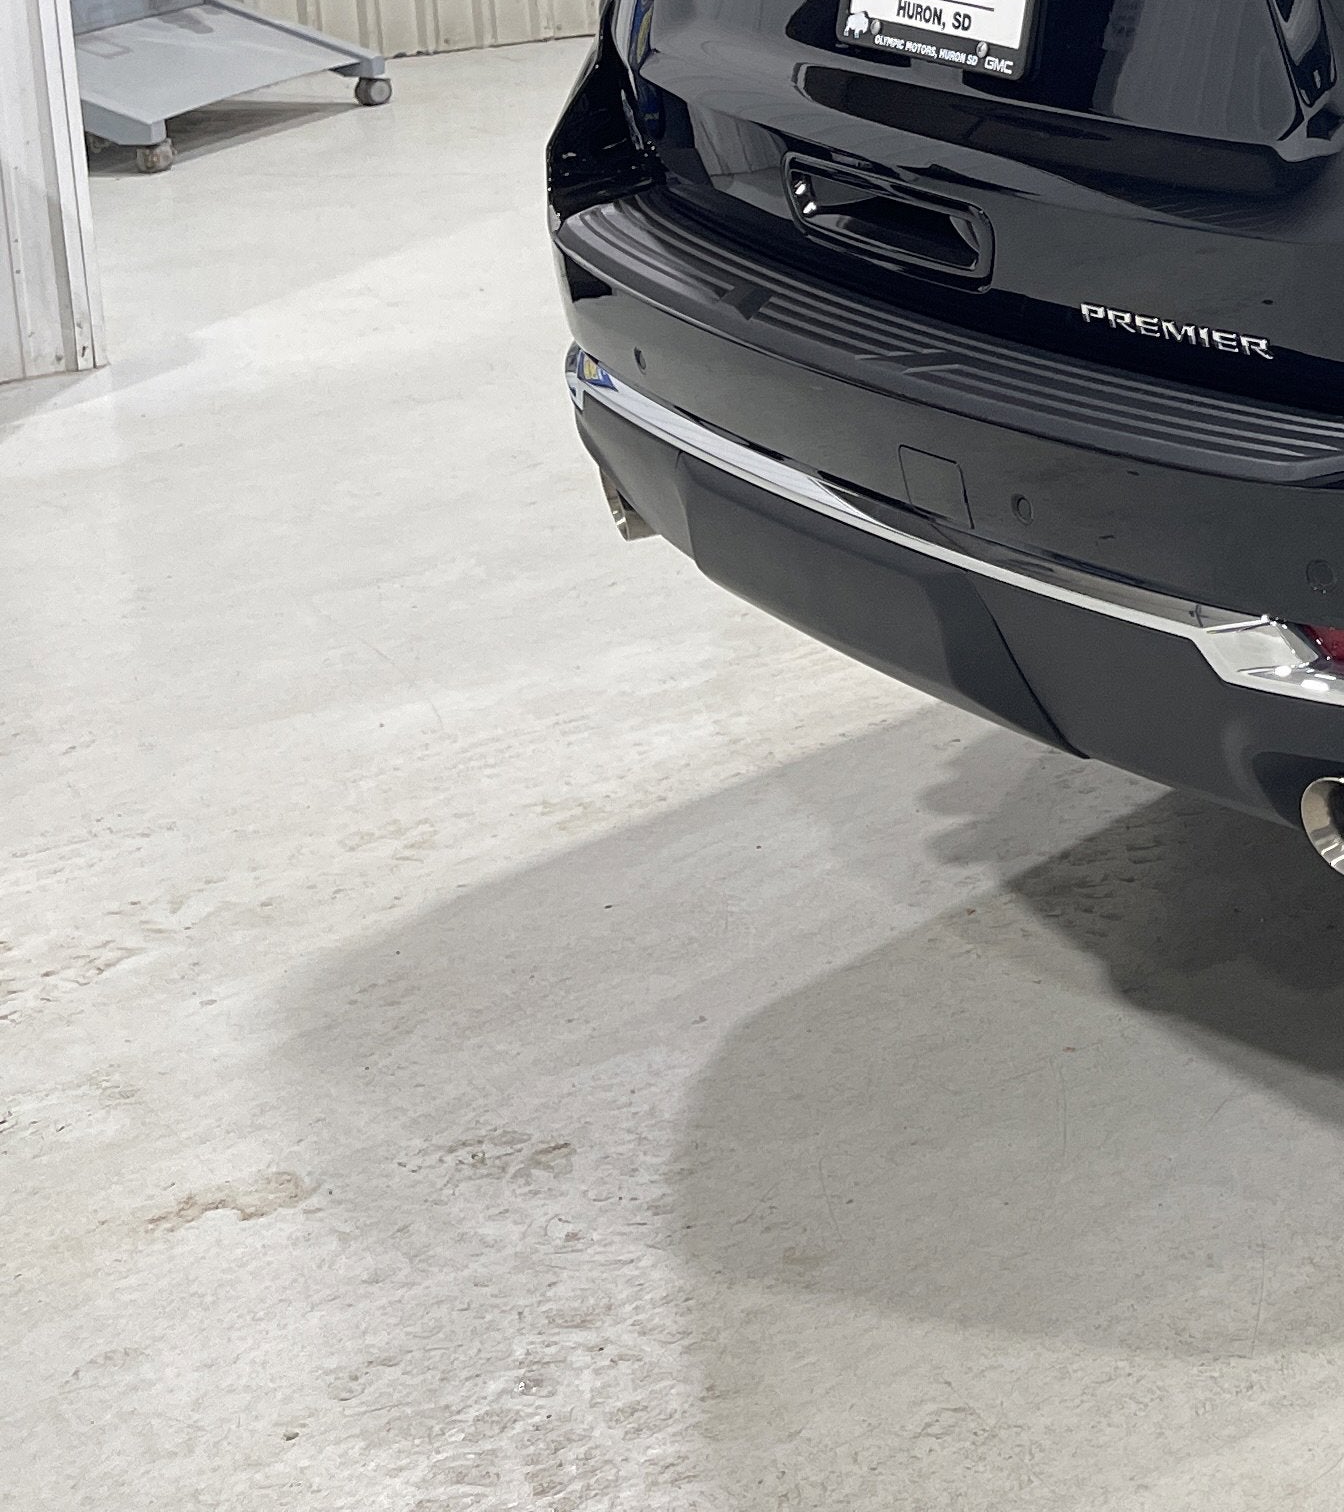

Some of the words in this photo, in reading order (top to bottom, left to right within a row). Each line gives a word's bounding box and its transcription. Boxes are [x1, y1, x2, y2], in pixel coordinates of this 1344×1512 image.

[896, 0, 946, 31] HURON,
[951, 10, 972, 32] SD
[874, 34, 904, 51] OLYMPIC
[904, 40, 938, 59] MOTORS,
[939, 47, 966, 63] HURON
[966, 53, 979, 66] SD
[983, 54, 1014, 75] GMC
[1080, 302, 1275, 360] PREMIER
